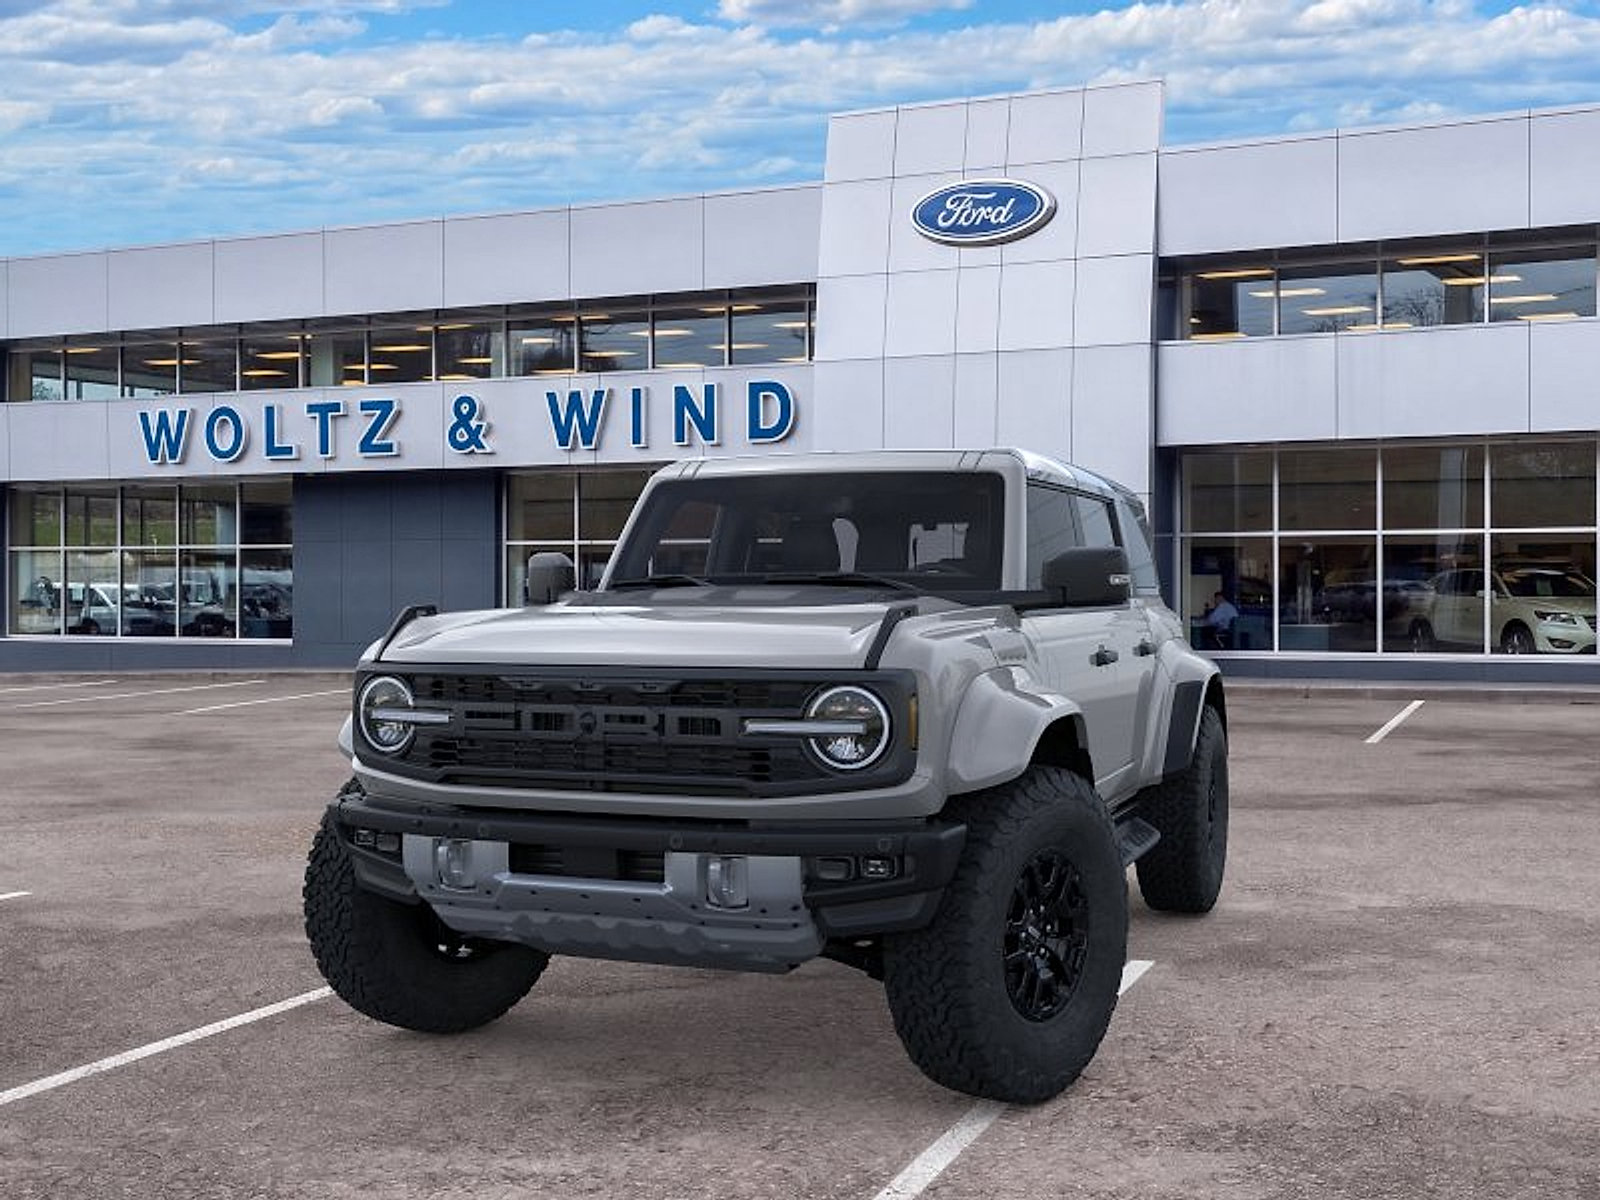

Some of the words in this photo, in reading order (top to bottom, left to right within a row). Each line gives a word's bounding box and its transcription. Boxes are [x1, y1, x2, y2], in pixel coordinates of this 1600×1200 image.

[937, 191, 1015, 228] Ford
[138, 397, 400, 464] WOLTZ
[447, 394, 493, 455] &
[546, 380, 796, 450] WIND
[452, 702, 735, 745] FORD
